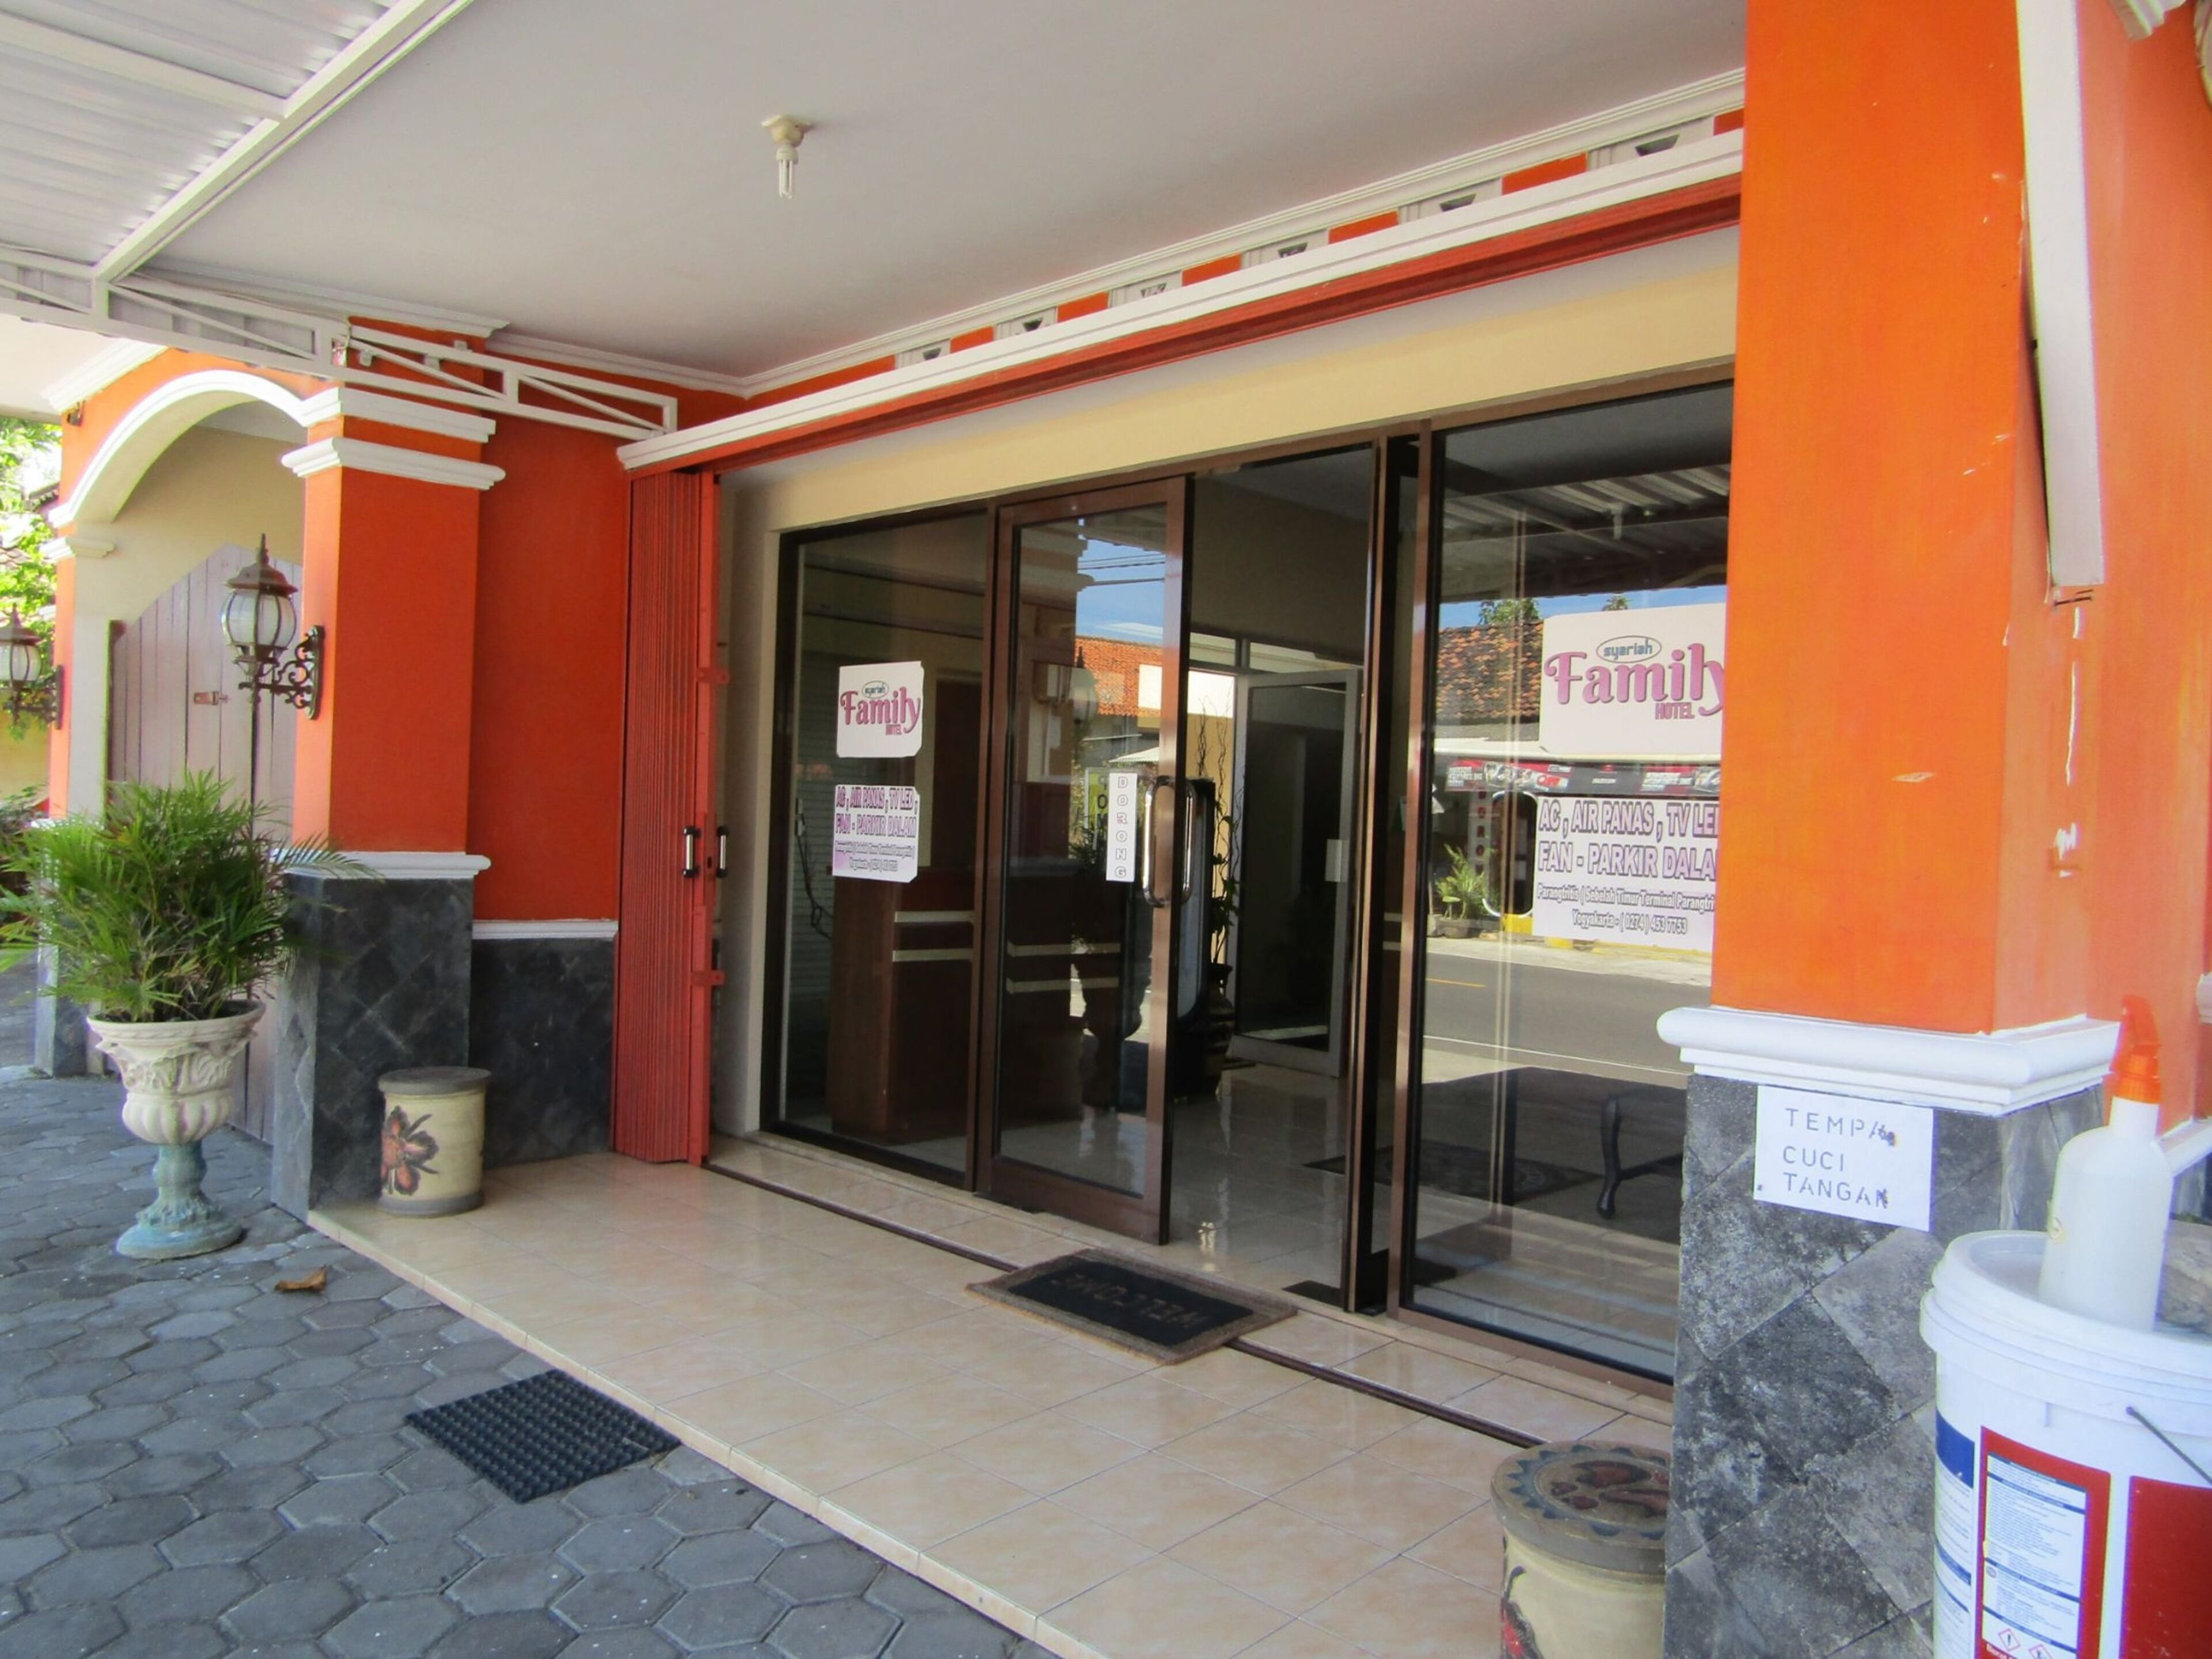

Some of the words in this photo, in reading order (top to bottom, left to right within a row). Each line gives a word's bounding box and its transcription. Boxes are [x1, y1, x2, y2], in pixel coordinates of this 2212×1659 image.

[1604, 639, 1653, 660] syariah
[1544, 643, 1725, 717] Family
[840, 686, 921, 734] Family
[1655, 702, 1695, 720] HOTEL
[888, 816, 917, 838] DALAM
[1115, 776, 1128, 878] DORONG
[1539, 799, 1562, 831] AC
[1570, 800, 1599, 834] AIR
[1601, 801, 1655, 835] PANAS
[1666, 802, 1691, 837] TV
[1537, 840, 1573, 873] FAN
[1587, 842, 1658, 878] PARKIR
[1662, 846, 1717, 882] DALA
[1585, 886, 1615, 904] Sebelah
[1616, 888, 1640, 906] Timur
[1640, 889, 1676, 908] Terminal
[1572, 908, 1615, 929] Yogyakarta
[1650, 915, 1665, 933] 453
[1666, 916, 1688, 934] 7753
[1783, 1145, 1844, 1172] CUCI
